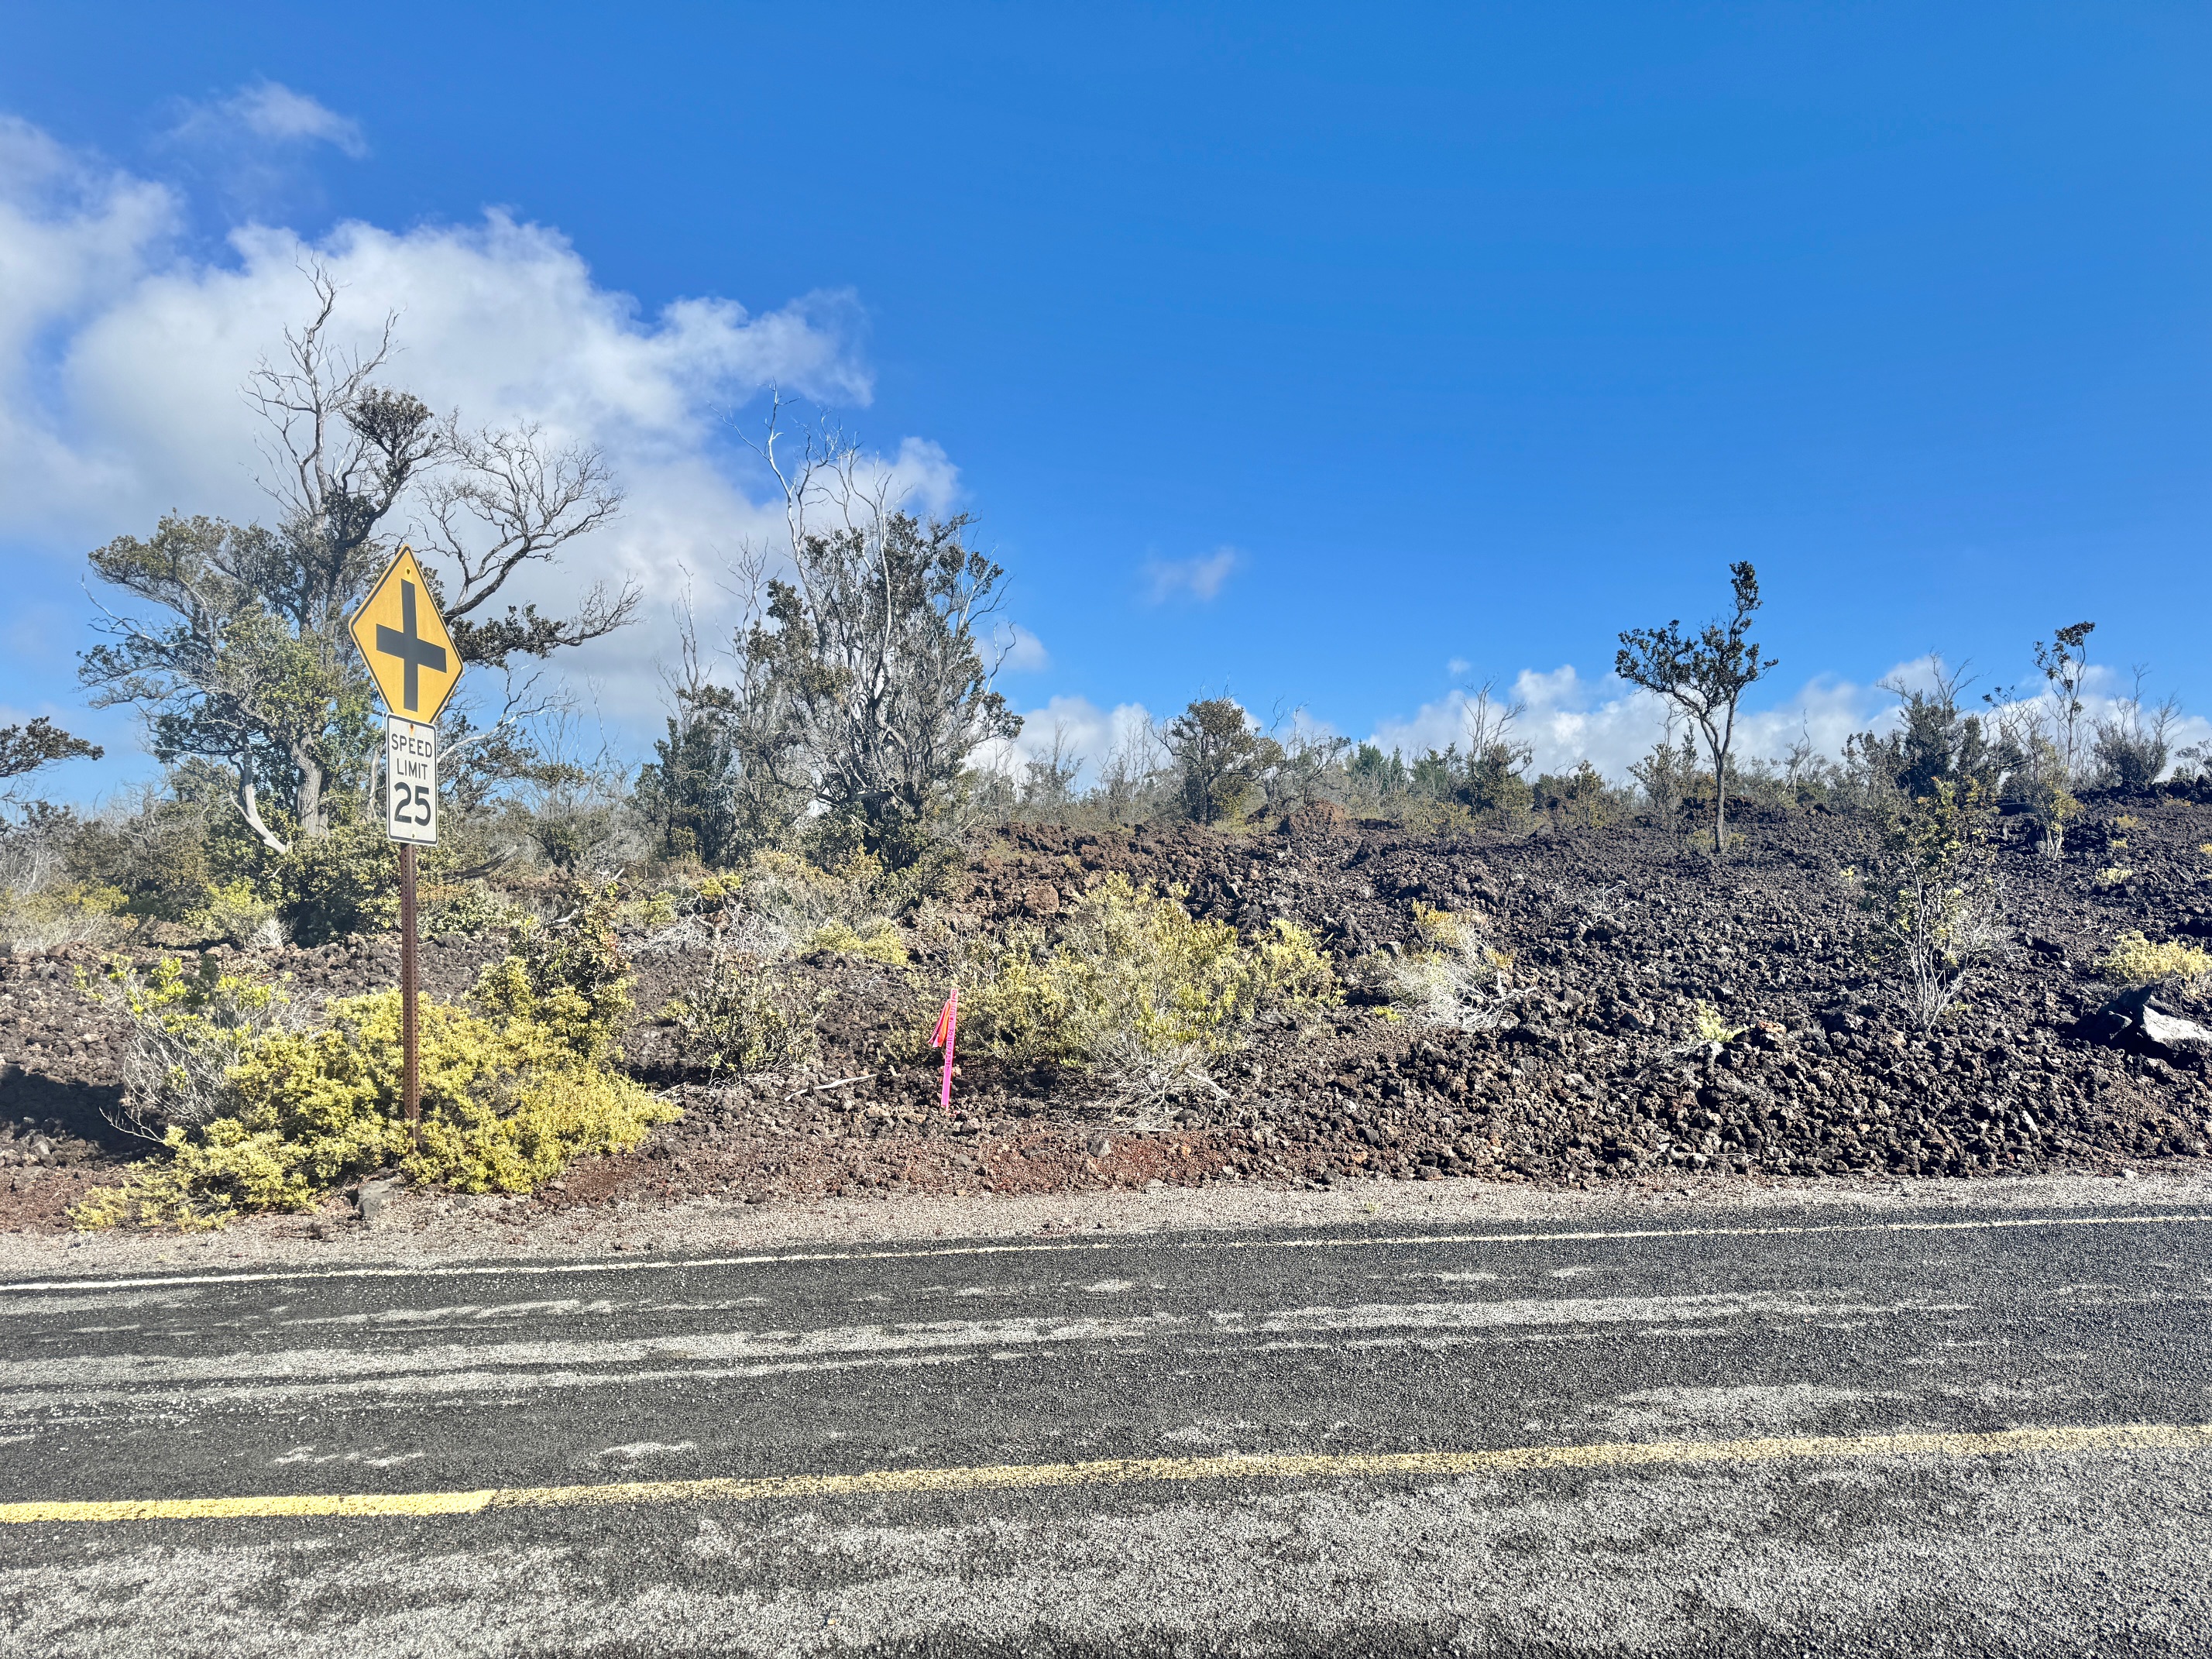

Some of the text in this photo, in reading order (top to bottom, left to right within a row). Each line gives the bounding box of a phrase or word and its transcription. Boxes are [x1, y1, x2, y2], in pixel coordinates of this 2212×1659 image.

[391, 733, 432, 758] SPEED
[397, 757, 428, 780] LIMIT
[393, 781, 431, 826] 25
